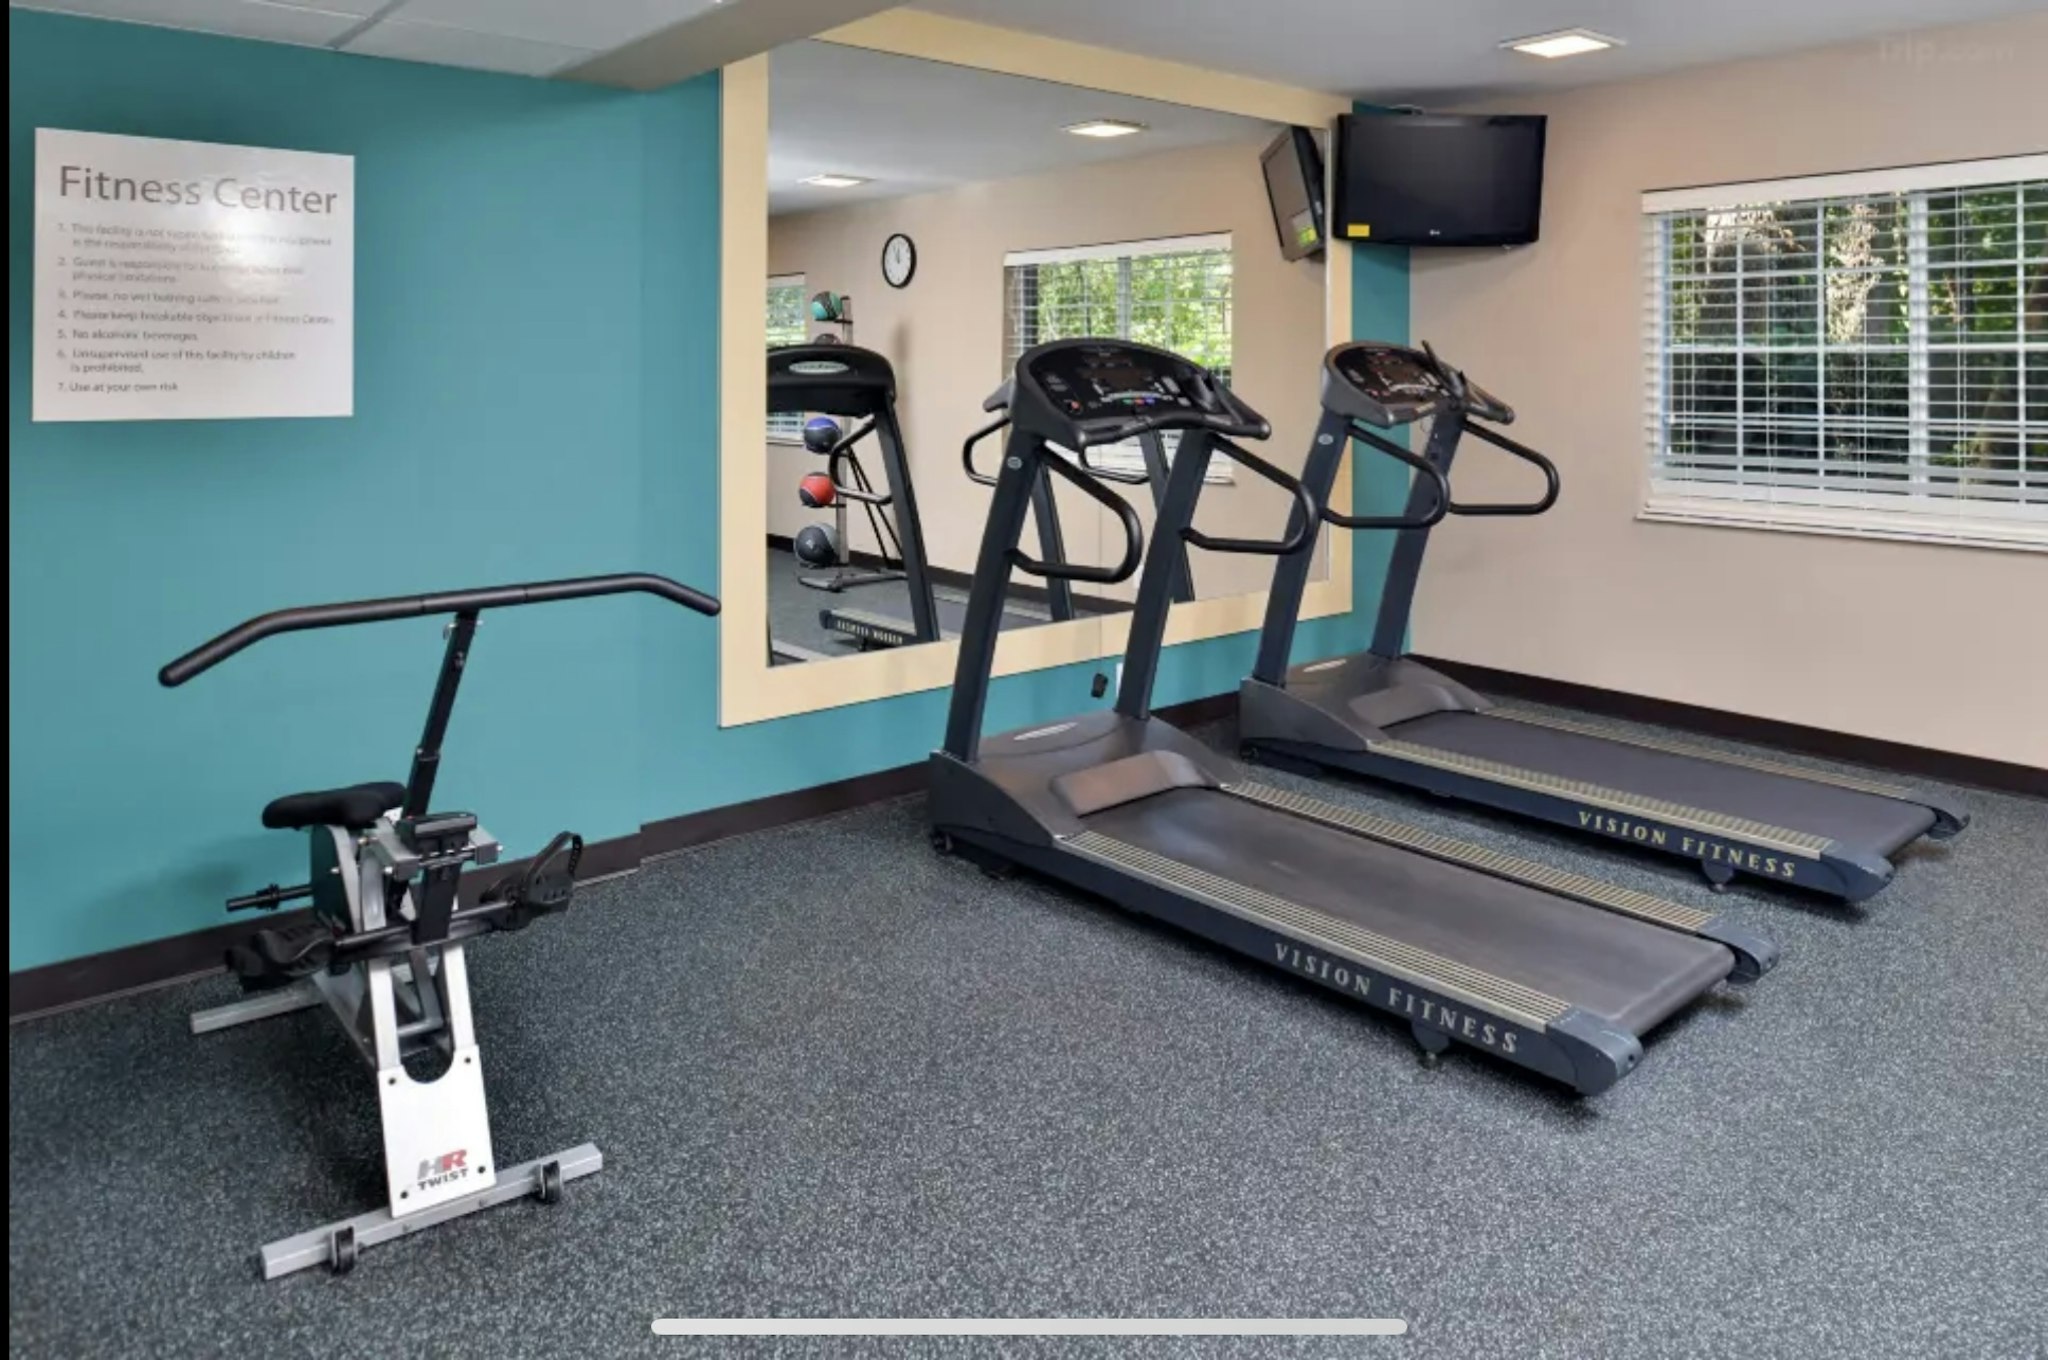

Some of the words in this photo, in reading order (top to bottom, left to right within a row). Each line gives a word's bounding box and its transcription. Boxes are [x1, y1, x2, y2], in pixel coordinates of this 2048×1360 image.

[60, 165, 201, 205] Fitness
[213, 178, 337, 214] Center
[72, 223, 95, 235] This
[96, 224, 133, 238] facility
[73, 257, 107, 267] Guest
[153, 292, 196, 304] bathing
[73, 309, 109, 320] Please
[111, 309, 138, 322] keep
[73, 328, 89, 339] No
[91, 328, 138, 339] alcoholic
[73, 348, 149, 360] Unsupervised
[151, 351, 170, 360] use
[171, 349, 183, 360] of
[185, 349, 205, 360] this
[206, 349, 239, 361] facility
[240, 350, 255, 361] by
[256, 350, 297, 361] children
[70, 362, 81, 373] is
[69, 381, 91, 392] Use
[92, 383, 104, 392] at
[106, 383, 131, 395] your
[133, 383, 158, 392] own
[1579, 811, 1667, 845] VISION
[1682, 837, 1796, 878] FITNESS
[1275, 942, 1371, 996] VISION
[1388, 987, 1518, 1054] FITNESS
[417, 1168, 469, 1191] TWIST
